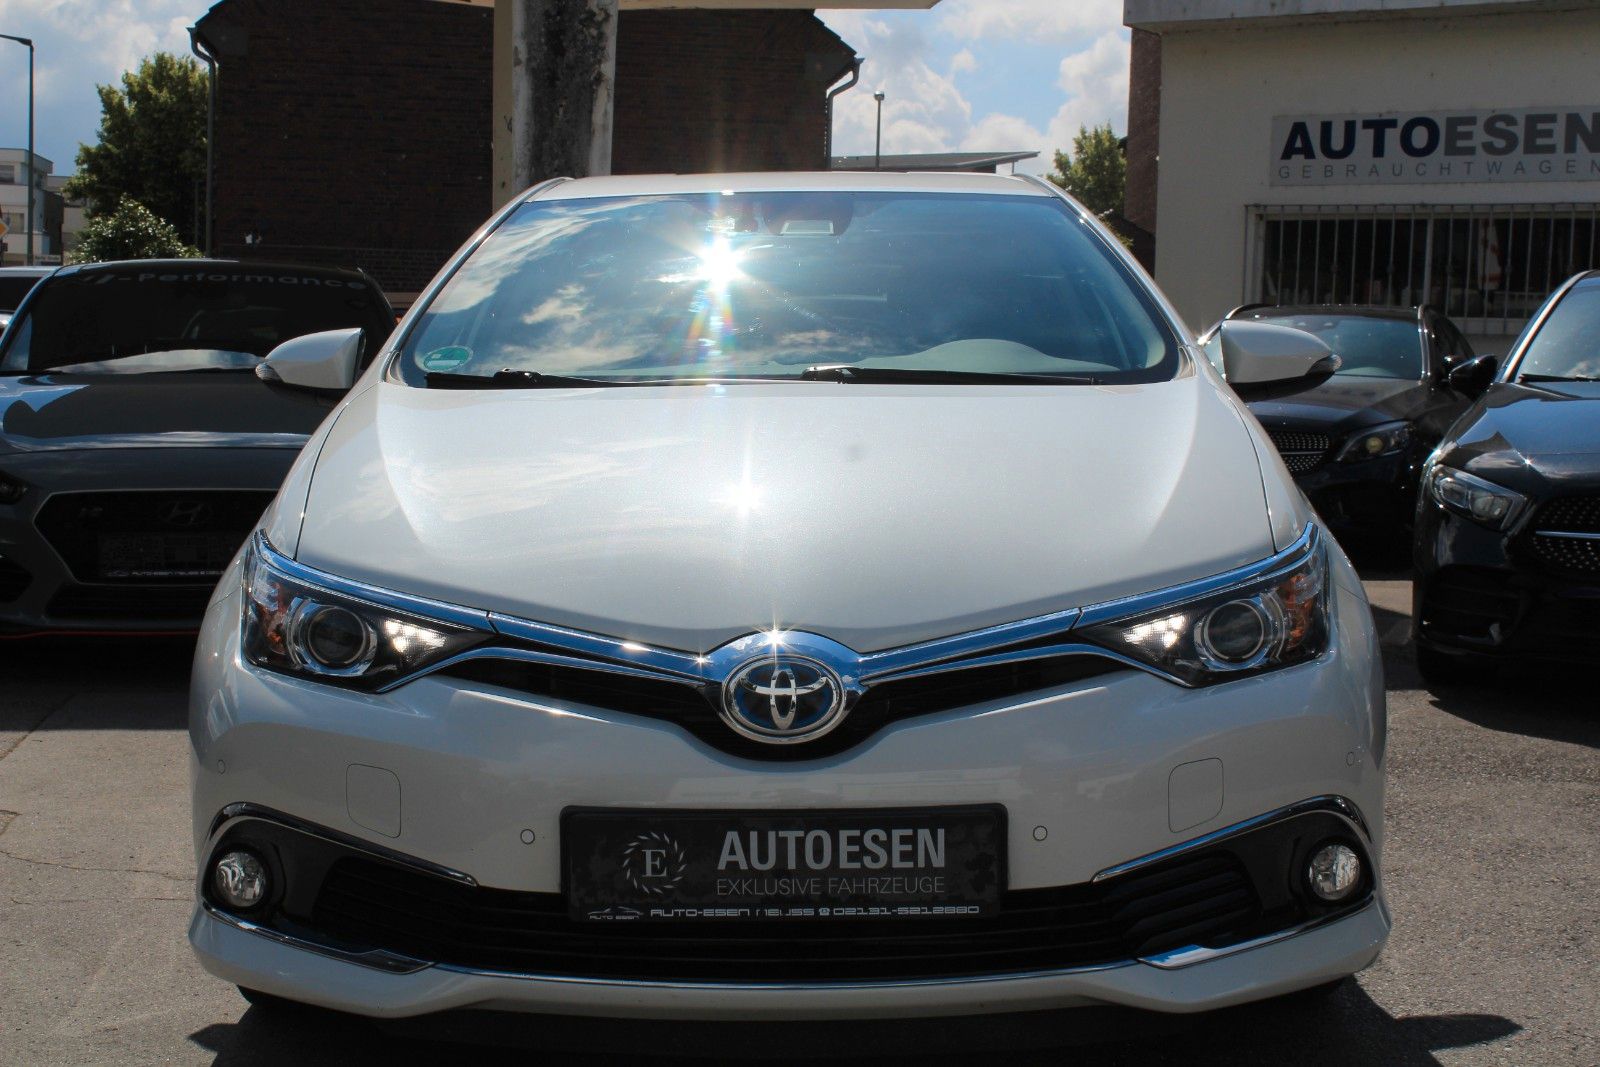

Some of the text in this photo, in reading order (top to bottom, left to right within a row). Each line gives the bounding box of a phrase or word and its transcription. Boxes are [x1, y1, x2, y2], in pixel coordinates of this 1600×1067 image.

[1280, 112, 1600, 160] AUTOESEN
[1278, 159, 1600, 179] GEBRAUCHTWAGEN
[717, 828, 946, 870] AUTOESEN
[716, 876, 945, 896] EXKLUSIVE FAHRZEUGE
